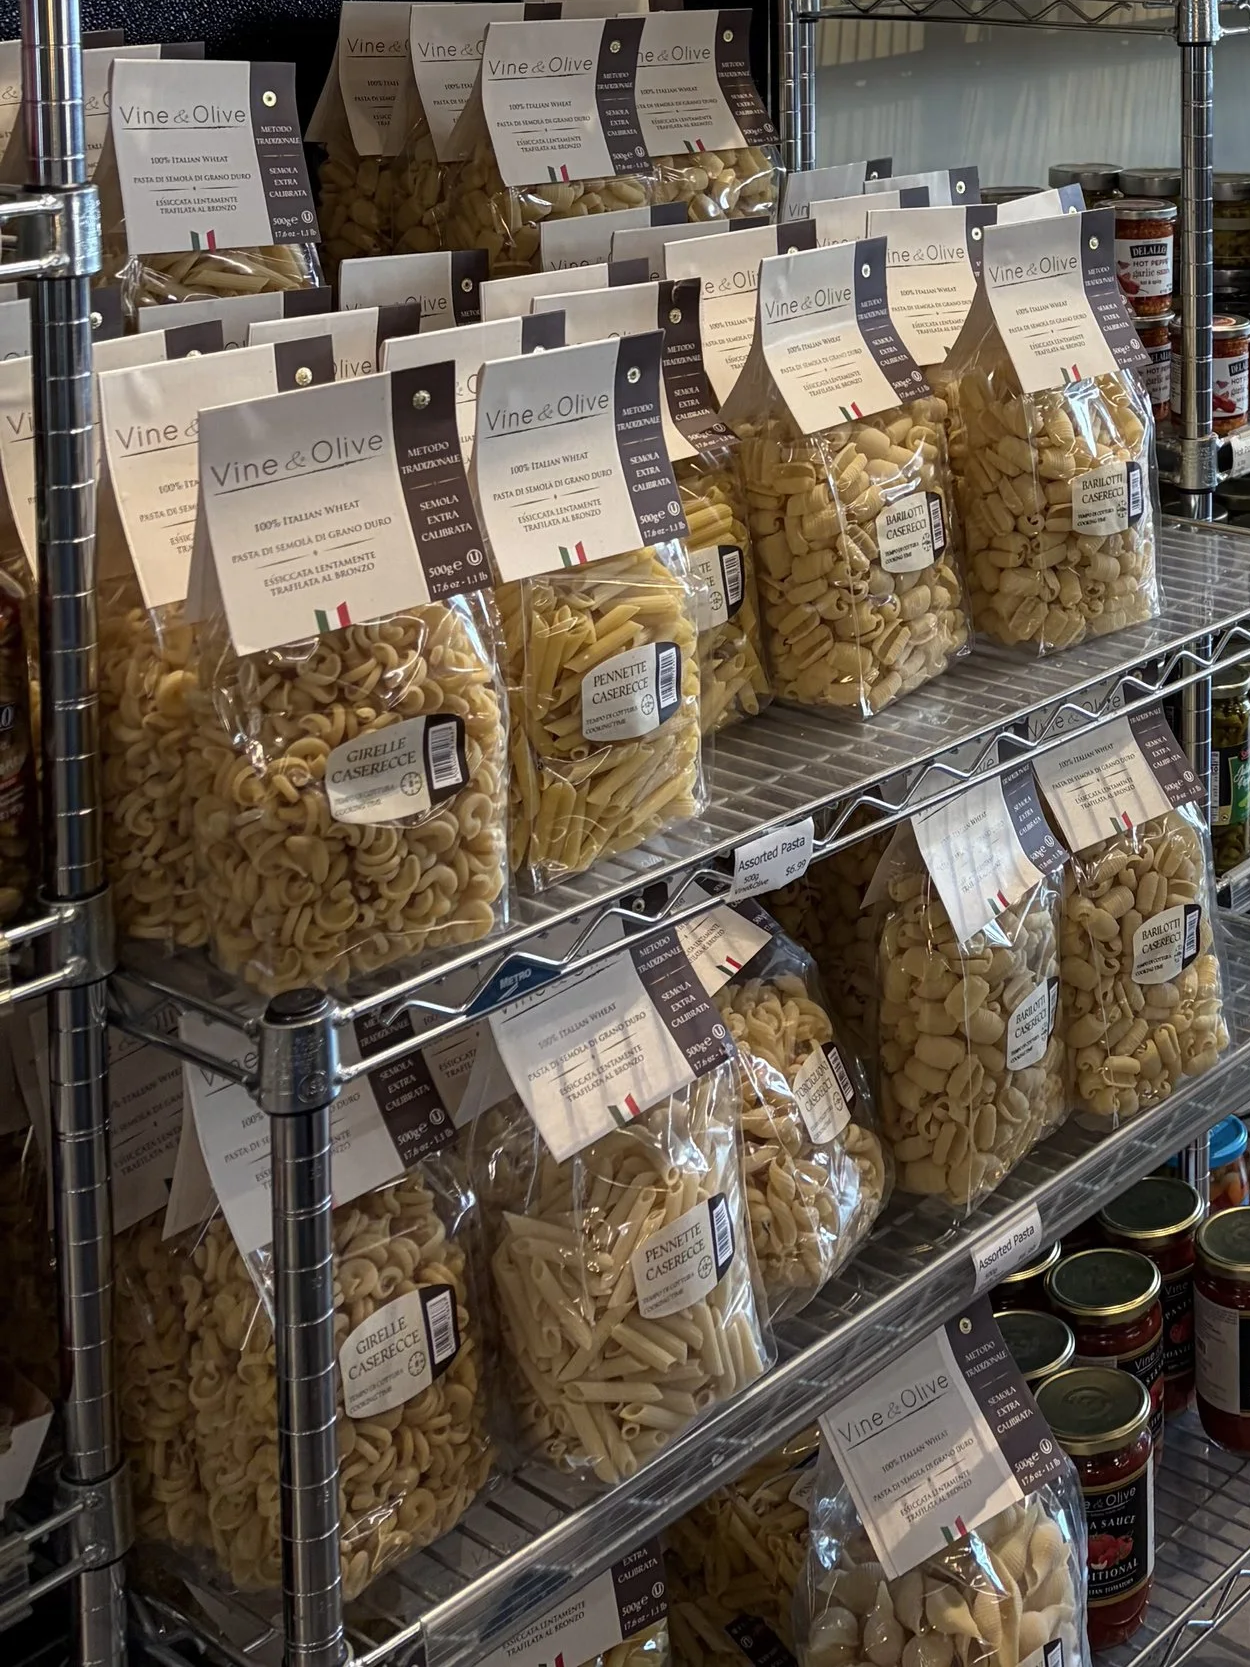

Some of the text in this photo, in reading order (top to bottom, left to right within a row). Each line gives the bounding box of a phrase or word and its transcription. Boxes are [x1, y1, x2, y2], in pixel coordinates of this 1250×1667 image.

[346, 37, 386, 53] Vine
[418, 41, 457, 57] Vine
[671, 45, 711, 61] Olive
[487, 55, 592, 76] Vine & Olive
[119, 105, 246, 123] Vine & Olive
[256, 137, 300, 145] TRADIZIONALE
[150, 155, 228, 165] 100% ITALIAN WHEAT
[269, 166, 299, 175] SEMOLA
[269, 189, 307, 198] CALIBRATA
[913, 245, 965, 260] & Olive
[1132, 246, 1167, 257] DELALLO
[989, 255, 1077, 283] Vine & Olive
[1132, 269, 1155, 279] garlic
[764, 286, 852, 318] Vine & Olive
[486, 393, 609, 430] Vine & Olive
[622, 404, 654, 416] METODO
[616, 416, 660, 432] TRADIZIONALE
[115, 422, 178, 450] Vine
[408, 442, 449, 457] METODO
[630, 452, 660, 465] SEMOLA
[211, 435, 383, 487] Vine & Olive
[401, 454, 460, 475] TRADIZIONALE
[511, 452, 588, 474] 100% ITALIAN WHEAT
[636, 466, 660, 478] EXTRA
[493, 469, 613, 501] PASTA GRANO DURO
[632, 478, 671, 492] CALIBRATA
[1082, 474, 1123, 490] BARILOTTI
[420, 495, 459, 511] SEMOLA
[556, 499, 602, 515] LENTAMENTE
[1082, 488, 1124, 504] CASERECCI
[255, 500, 360, 532] 100% ITALIAN WHEAT
[427, 511, 459, 524] EXTRA
[523, 509, 601, 532] TRAFILATA BRONZO
[886, 504, 924, 526] BARILOTTI
[232, 517, 392, 563] PASTA DI GRANO DURO
[421, 523, 472, 542] CALIBRATA
[886, 520, 928, 540] CASERECCI
[315, 551, 376, 574] LENTAMENTE
[271, 563, 375, 597] TRAFILATA BRONZO
[593, 661, 647, 687] PENNETTE
[592, 677, 649, 705] CASERECCE
[346, 737, 407, 763] GIRELLE
[331, 751, 417, 784] CASERECCE
[738, 836, 805, 872] Assorted Pasta
[744, 859, 807, 884] 500g $6.99
[1142, 918, 1180, 940] BARILOTTI
[639, 936, 671, 958] METODO
[1142, 932, 1182, 954] CASERECCI
[637, 946, 683, 973] TRADIZIONALE
[500, 968, 532, 988] METRO
[661, 982, 692, 1002] SEMOLA
[671, 993, 696, 1012] EXTRA
[671, 1003, 710, 1028] CALIBRATA
[1016, 995, 1046, 1024] BARILOTTI
[1014, 1009, 1047, 1039] CASERECCI
[645, 1222, 702, 1263] PENNETTE
[979, 1225, 1035, 1271] Assorted Pasta
[645, 1239, 706, 1281] CASERECCE
[355, 1316, 407, 1355] GIRELLE
[348, 1330, 421, 1381] CASERECCE
[965, 1340, 996, 1362] METODO
[965, 1350, 1008, 1379] TRADIZIONALE
[987, 1386, 1017, 1407] SEMOLA
[837, 1375, 949, 1443] Vine & Olive
[996, 1399, 1020, 1418] EXTRA
[996, 1409, 1034, 1434] CALIBRATA
[1106, 1487, 1136, 1507] Olive
[1101, 1515, 1135, 1528] SAUCE
